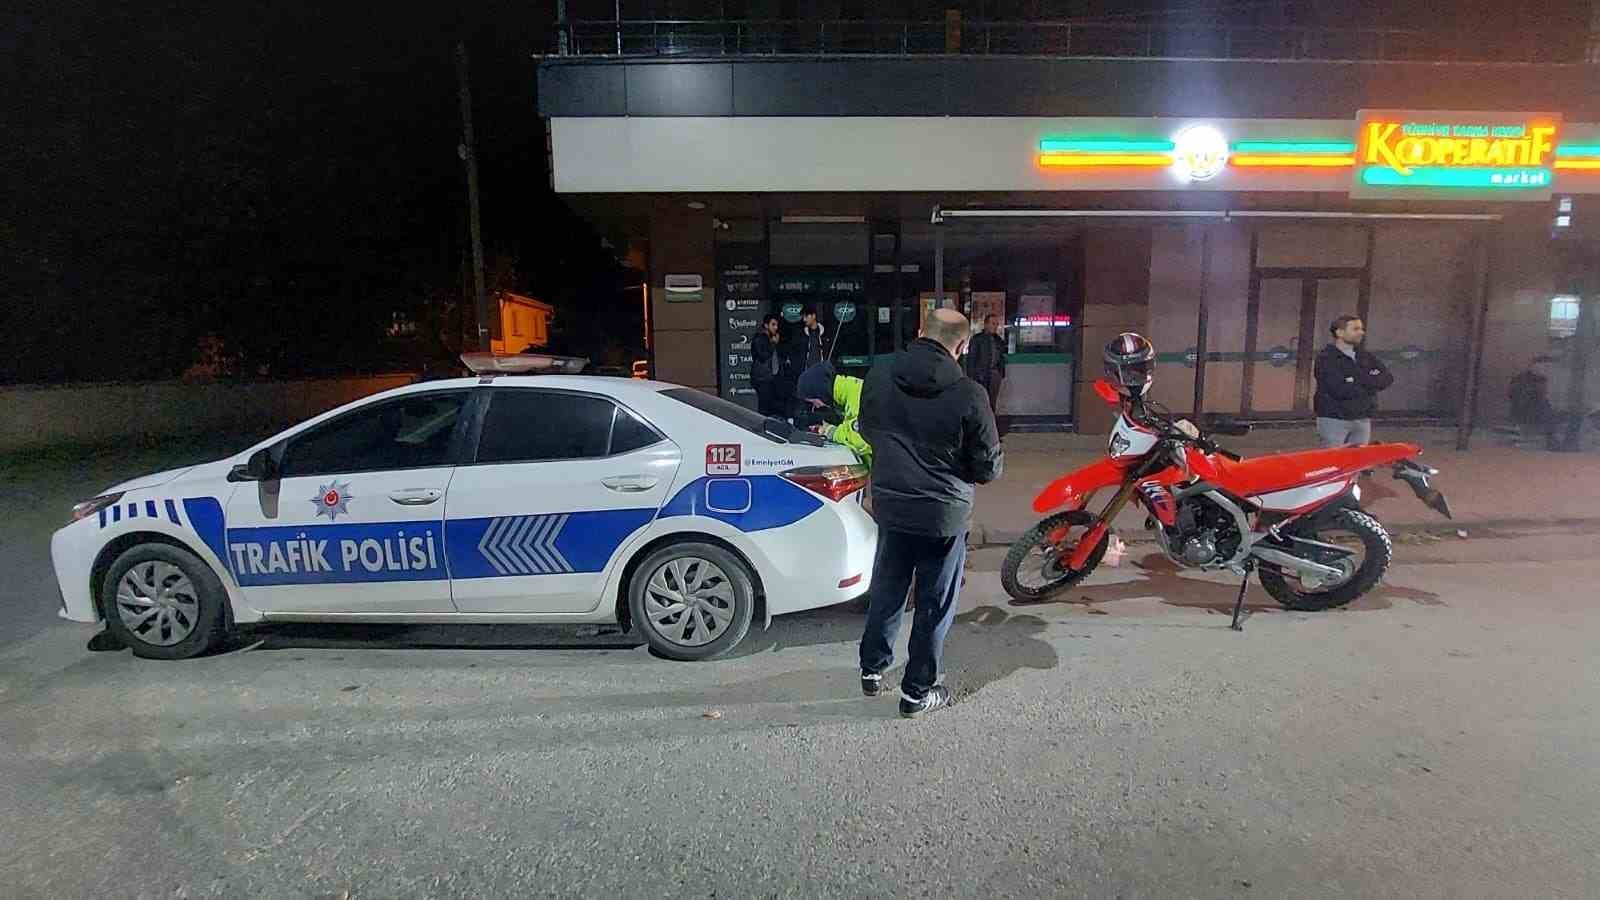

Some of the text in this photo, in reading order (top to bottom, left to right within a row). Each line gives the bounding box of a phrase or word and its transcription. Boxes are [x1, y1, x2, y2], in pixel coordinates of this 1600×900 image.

[1490, 170, 1545, 185] market
[710, 447, 737, 463] 112
[230, 530, 438, 576] TRAFİK POLİSİ
